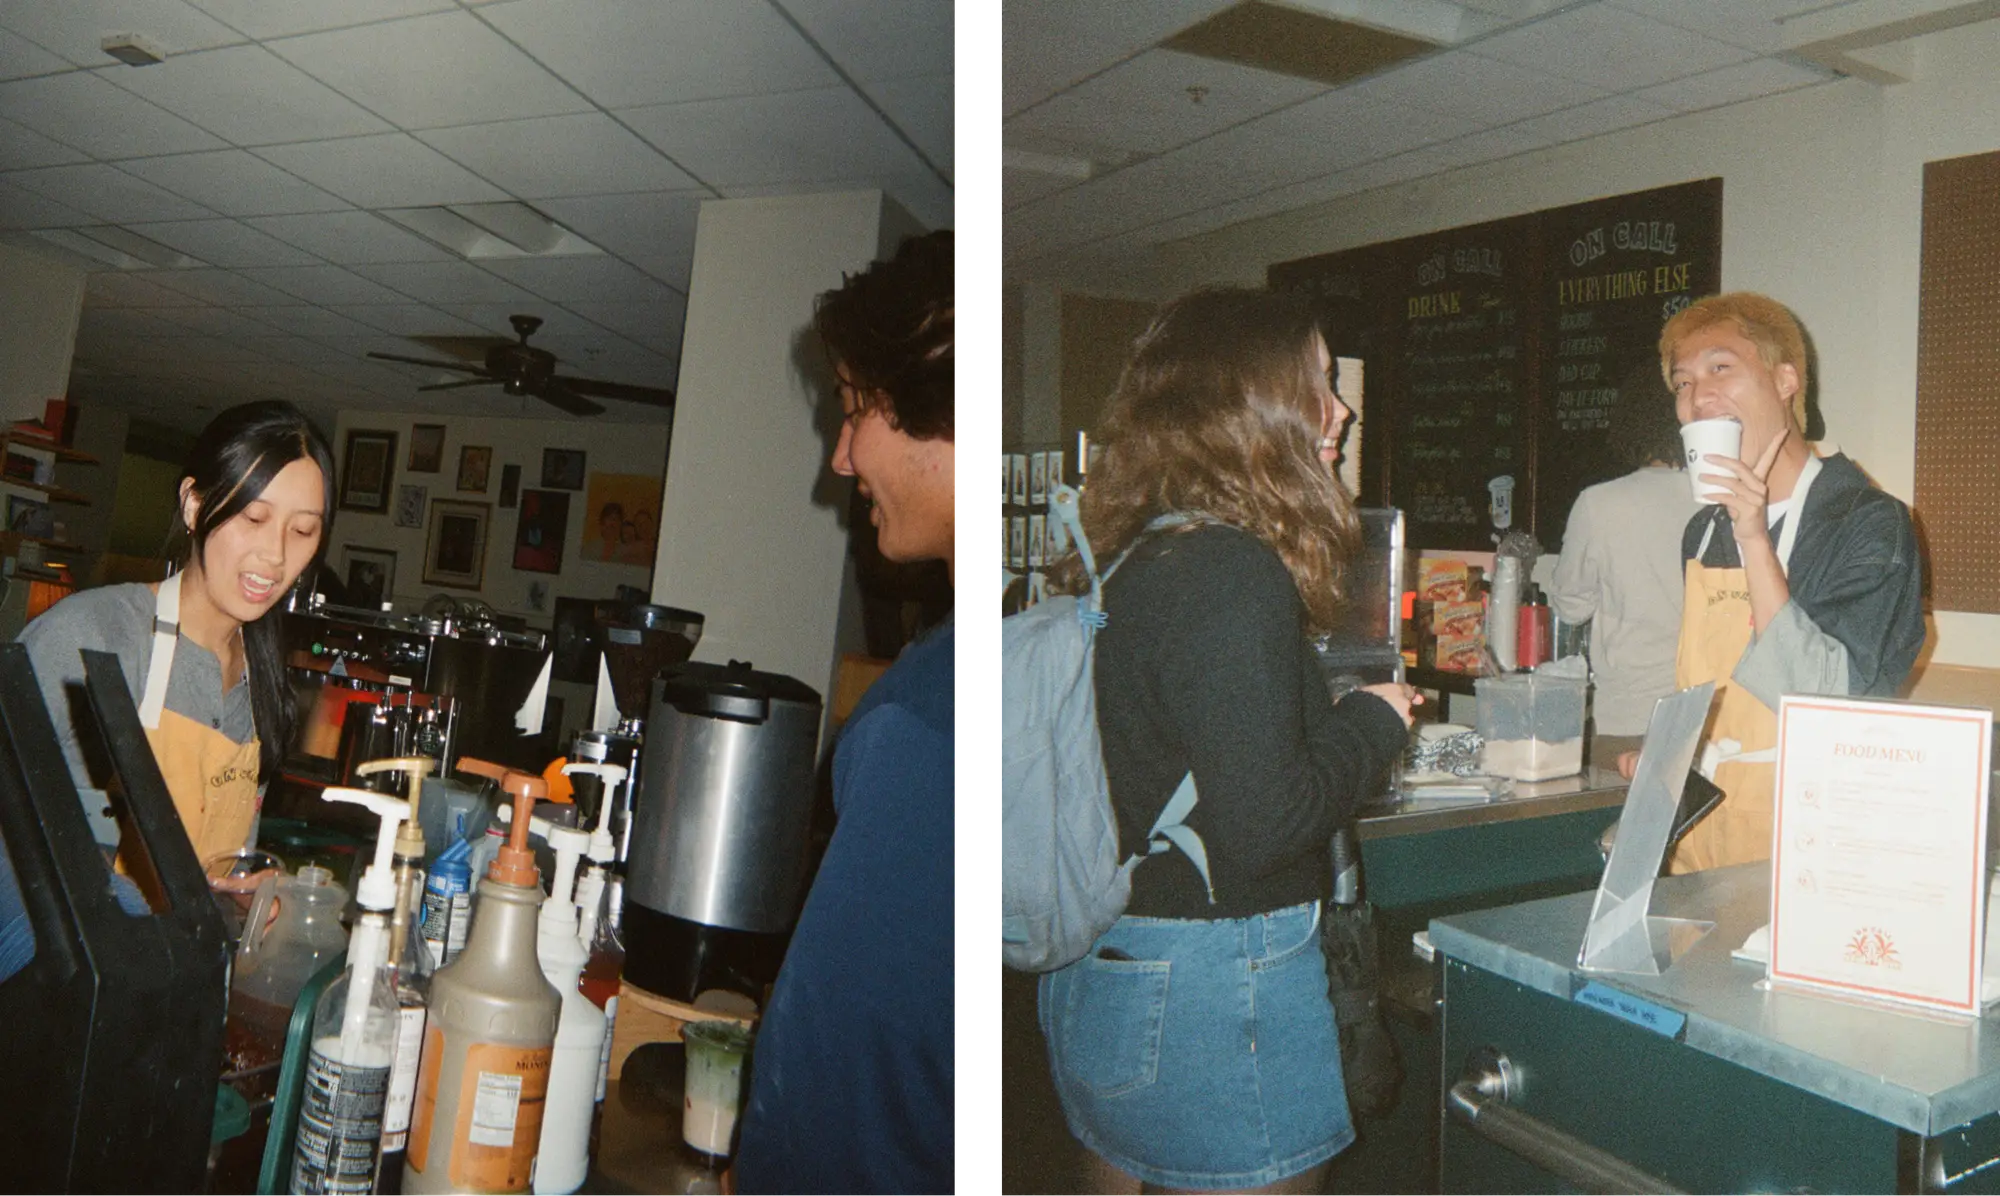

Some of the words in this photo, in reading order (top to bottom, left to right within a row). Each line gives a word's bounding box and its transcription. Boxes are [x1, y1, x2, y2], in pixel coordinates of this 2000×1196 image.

[1569, 228, 1606, 267] ON
[1613, 221, 1677, 255] CALL
[1558, 271, 1647, 306] EVERYTHING
[1654, 262, 1692, 294] ELSE
[1408, 291, 1461, 319] DRINK
[1833, 743, 1877, 759] FOOD
[1879, 746, 1928, 764] MENU
